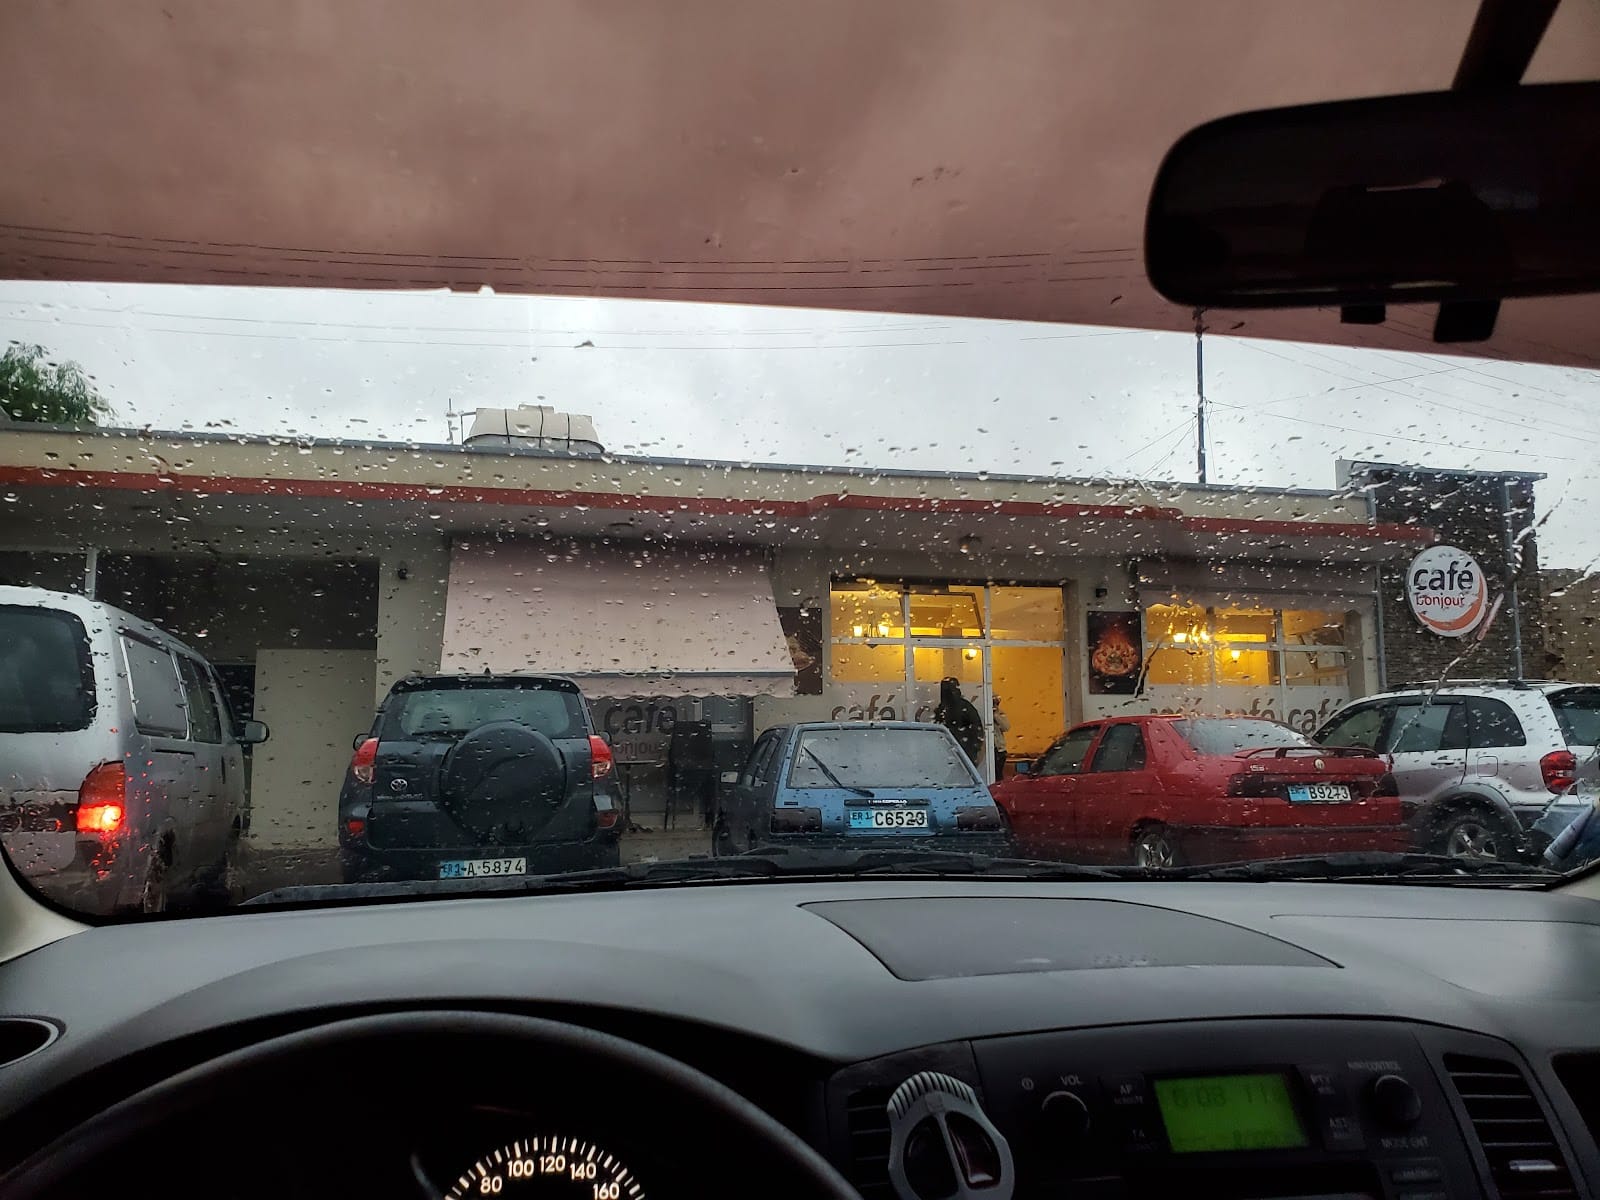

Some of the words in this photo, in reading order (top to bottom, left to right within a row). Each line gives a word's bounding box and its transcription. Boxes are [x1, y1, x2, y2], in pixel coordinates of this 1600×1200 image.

[1413, 560, 1474, 591] café
[1415, 592, 1465, 609] bonjour
[1287, 698, 1343, 734] caf
[1309, 786, 1349, 799] B9273
[1060, 1074, 1083, 1086] VOL
[480, 1175, 503, 1194] 80
[507, 1159, 535, 1178] 100
[539, 1154, 566, 1172] 120
[569, 1161, 597, 1180] 140
[592, 1182, 620, 1200] 160
